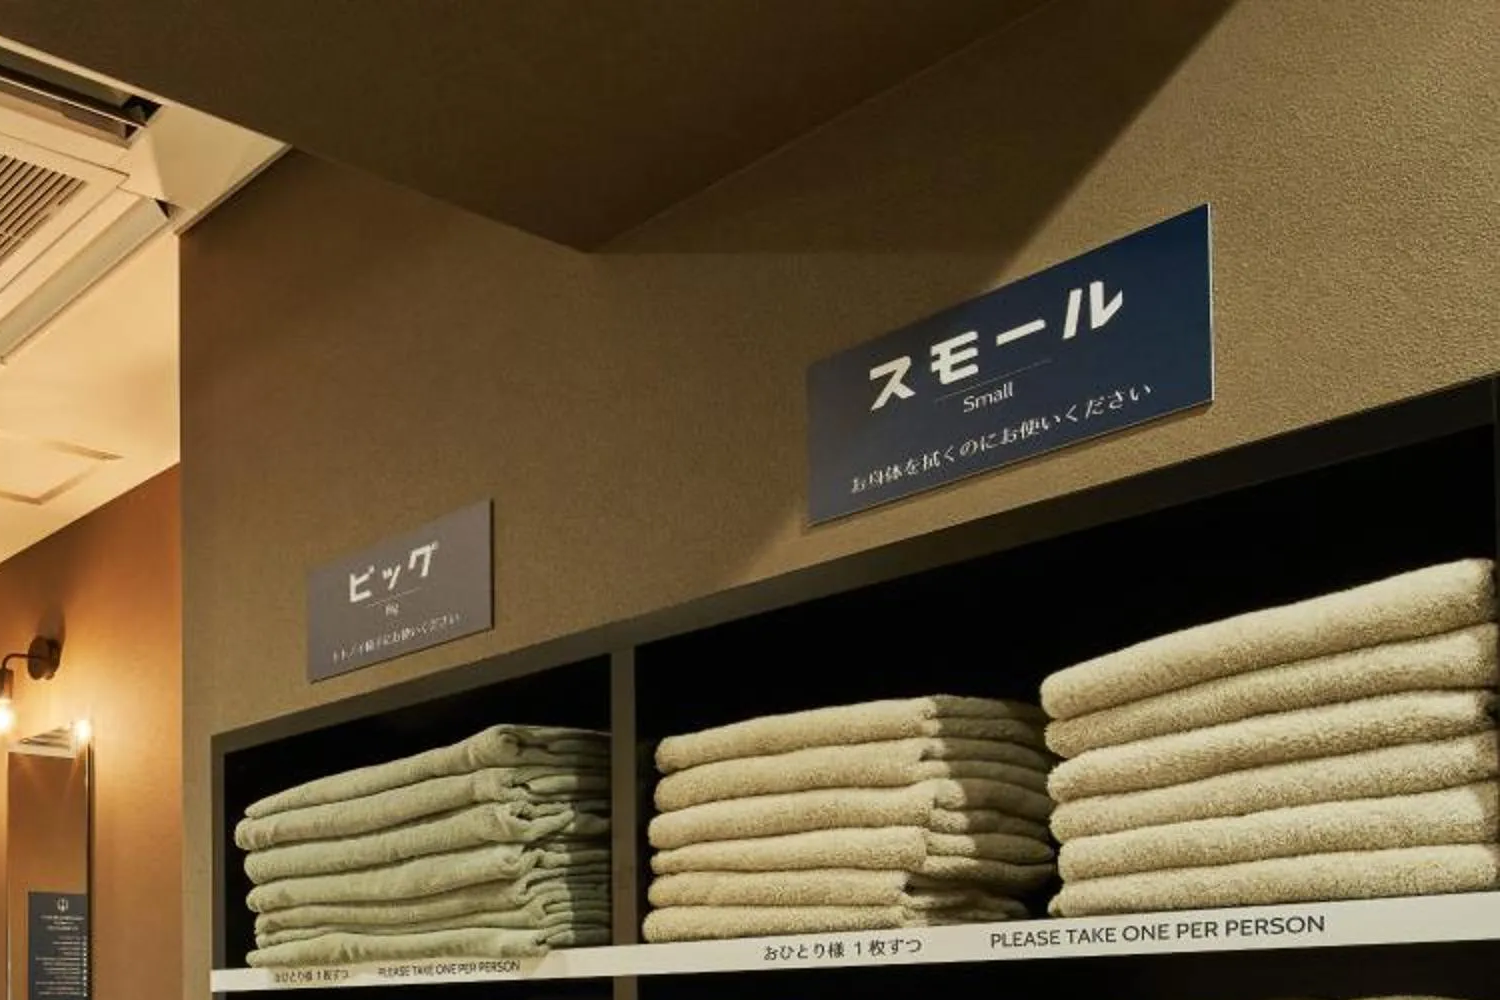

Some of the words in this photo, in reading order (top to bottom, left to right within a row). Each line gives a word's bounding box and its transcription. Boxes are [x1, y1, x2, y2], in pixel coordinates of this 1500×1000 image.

[869, 280, 1123, 412] スモール
[963, 381, 1013, 413] Small
[349, 540, 439, 603] ビッグ
[990, 928, 1061, 948] PLEASE
[1065, 926, 1117, 945] TAKE
[1121, 923, 1170, 942] ONE
[1176, 921, 1219, 939] PER
[1225, 915, 1325, 937] PERSON
[435, 963, 457, 975] ONE
[478, 960, 520, 973] PERSON
